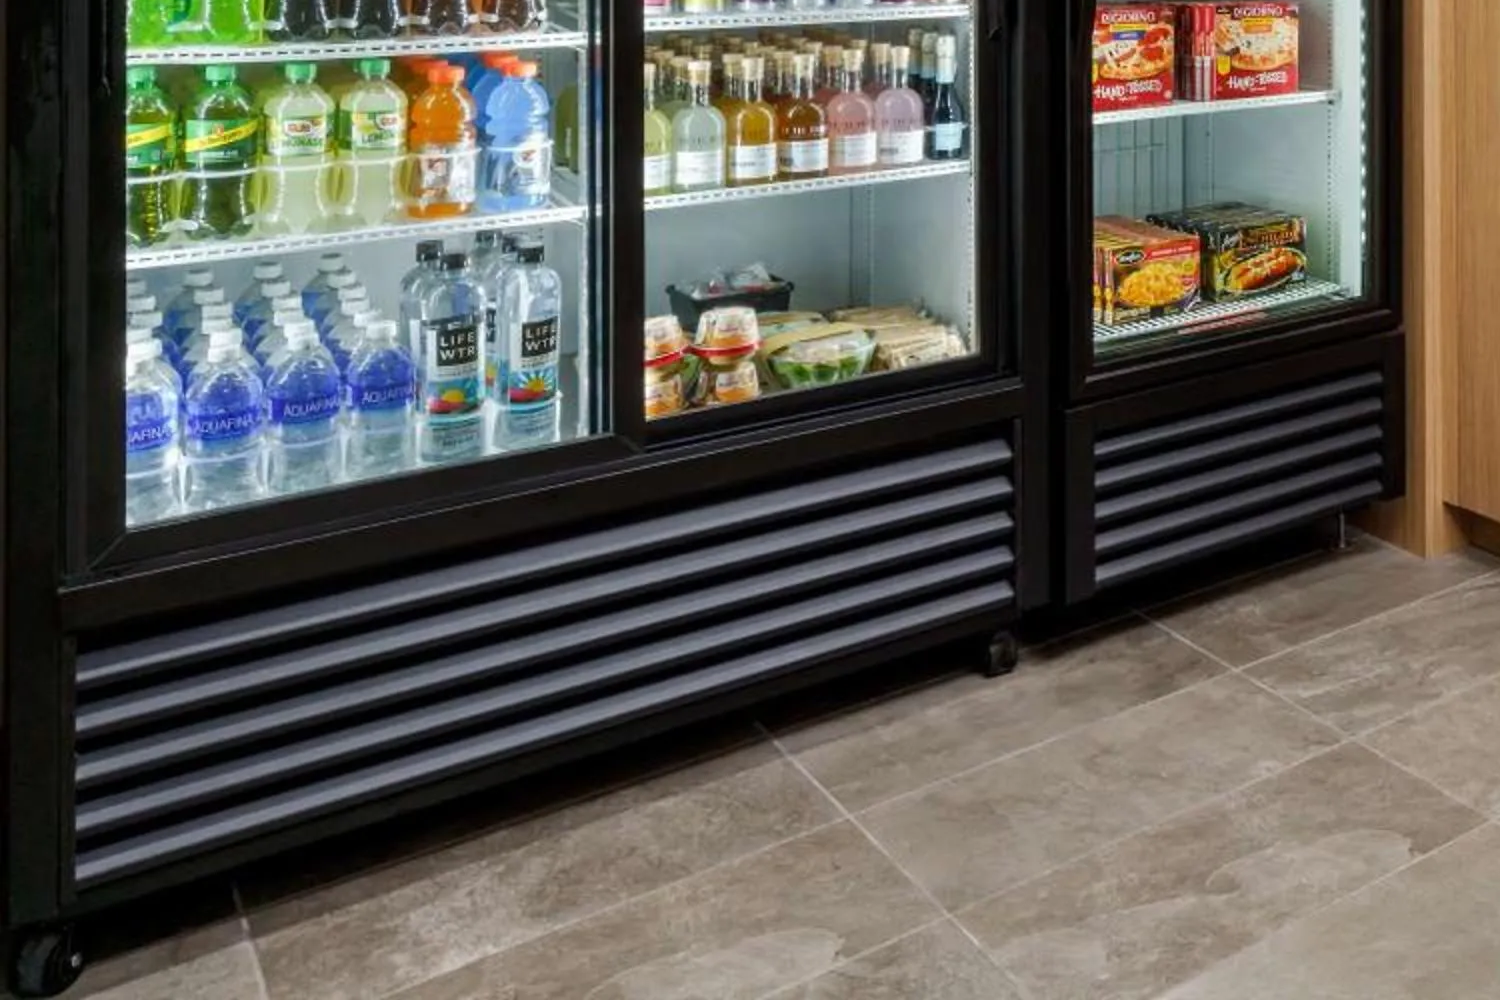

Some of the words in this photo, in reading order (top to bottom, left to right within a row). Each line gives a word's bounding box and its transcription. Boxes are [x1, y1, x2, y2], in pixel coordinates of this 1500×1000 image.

[524, 321, 558, 338] LIFE
[439, 330, 474, 348] LIFE
[439, 347, 474, 361] WTR
